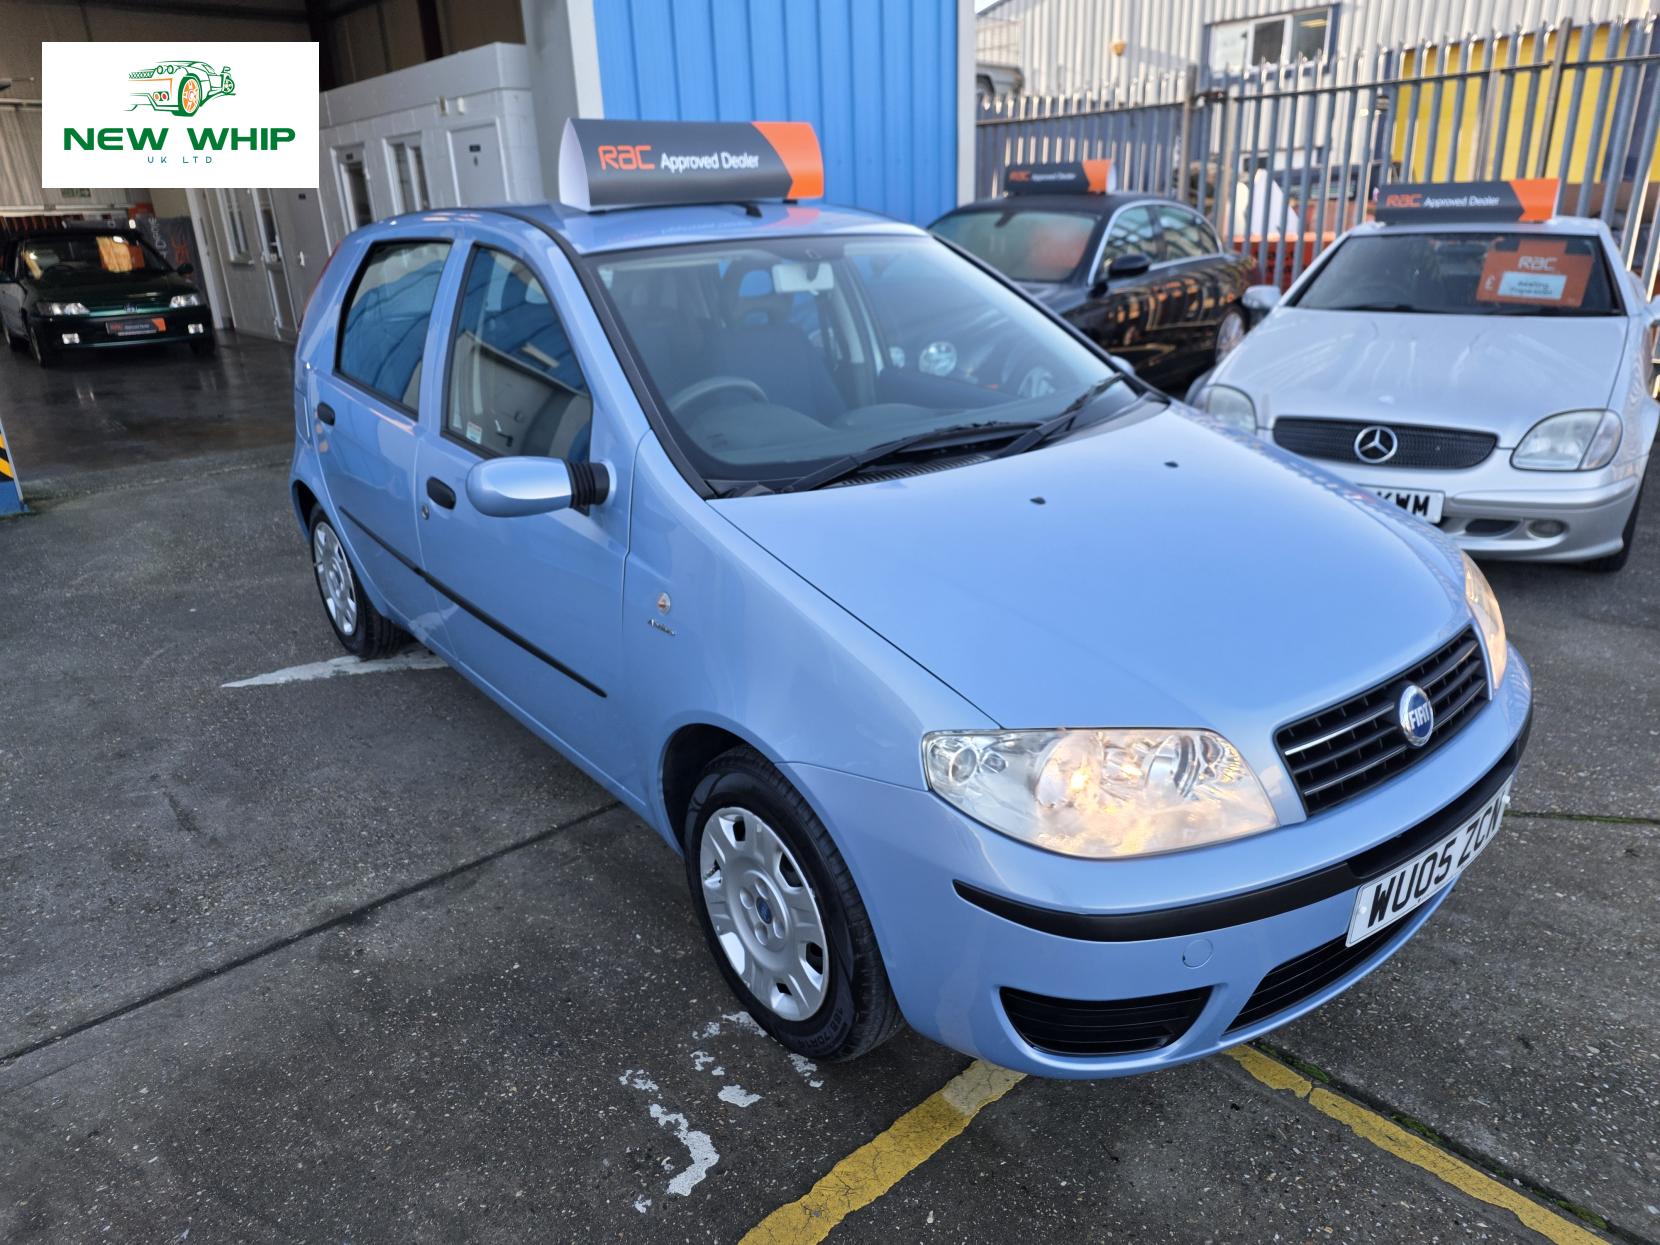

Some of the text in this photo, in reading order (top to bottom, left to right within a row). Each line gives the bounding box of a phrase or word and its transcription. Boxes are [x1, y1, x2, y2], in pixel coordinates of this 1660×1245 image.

[598, 144, 759, 173] RAC Approved Dealer
[1423, 197, 1468, 209] Approved
[1468, 194, 1500, 207] Dealer
[1408, 701, 1430, 730] FIAT
[1367, 790, 1506, 929] WU05 ZCN
